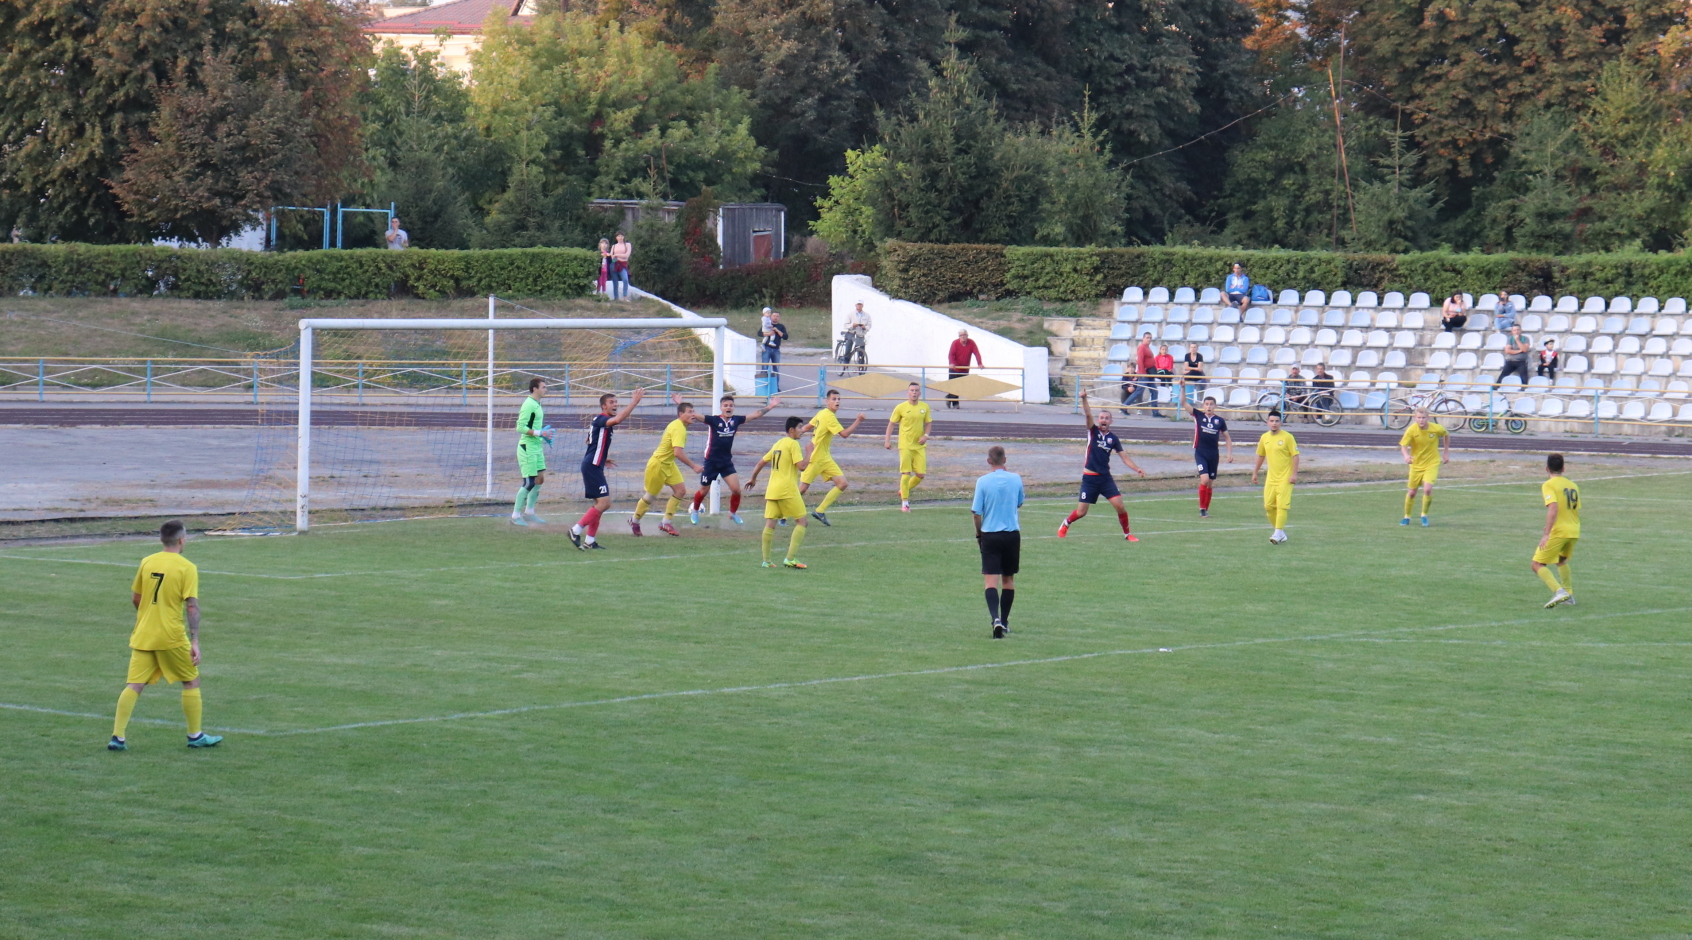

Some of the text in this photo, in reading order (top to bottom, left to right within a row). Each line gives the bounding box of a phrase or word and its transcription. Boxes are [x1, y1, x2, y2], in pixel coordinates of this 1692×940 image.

[772, 449, 782, 470] 17
[599, 485, 607, 494] 21
[1081, 491, 1087, 500] 8
[1563, 487, 1579, 511] 19
[151, 572, 165, 605] 7
